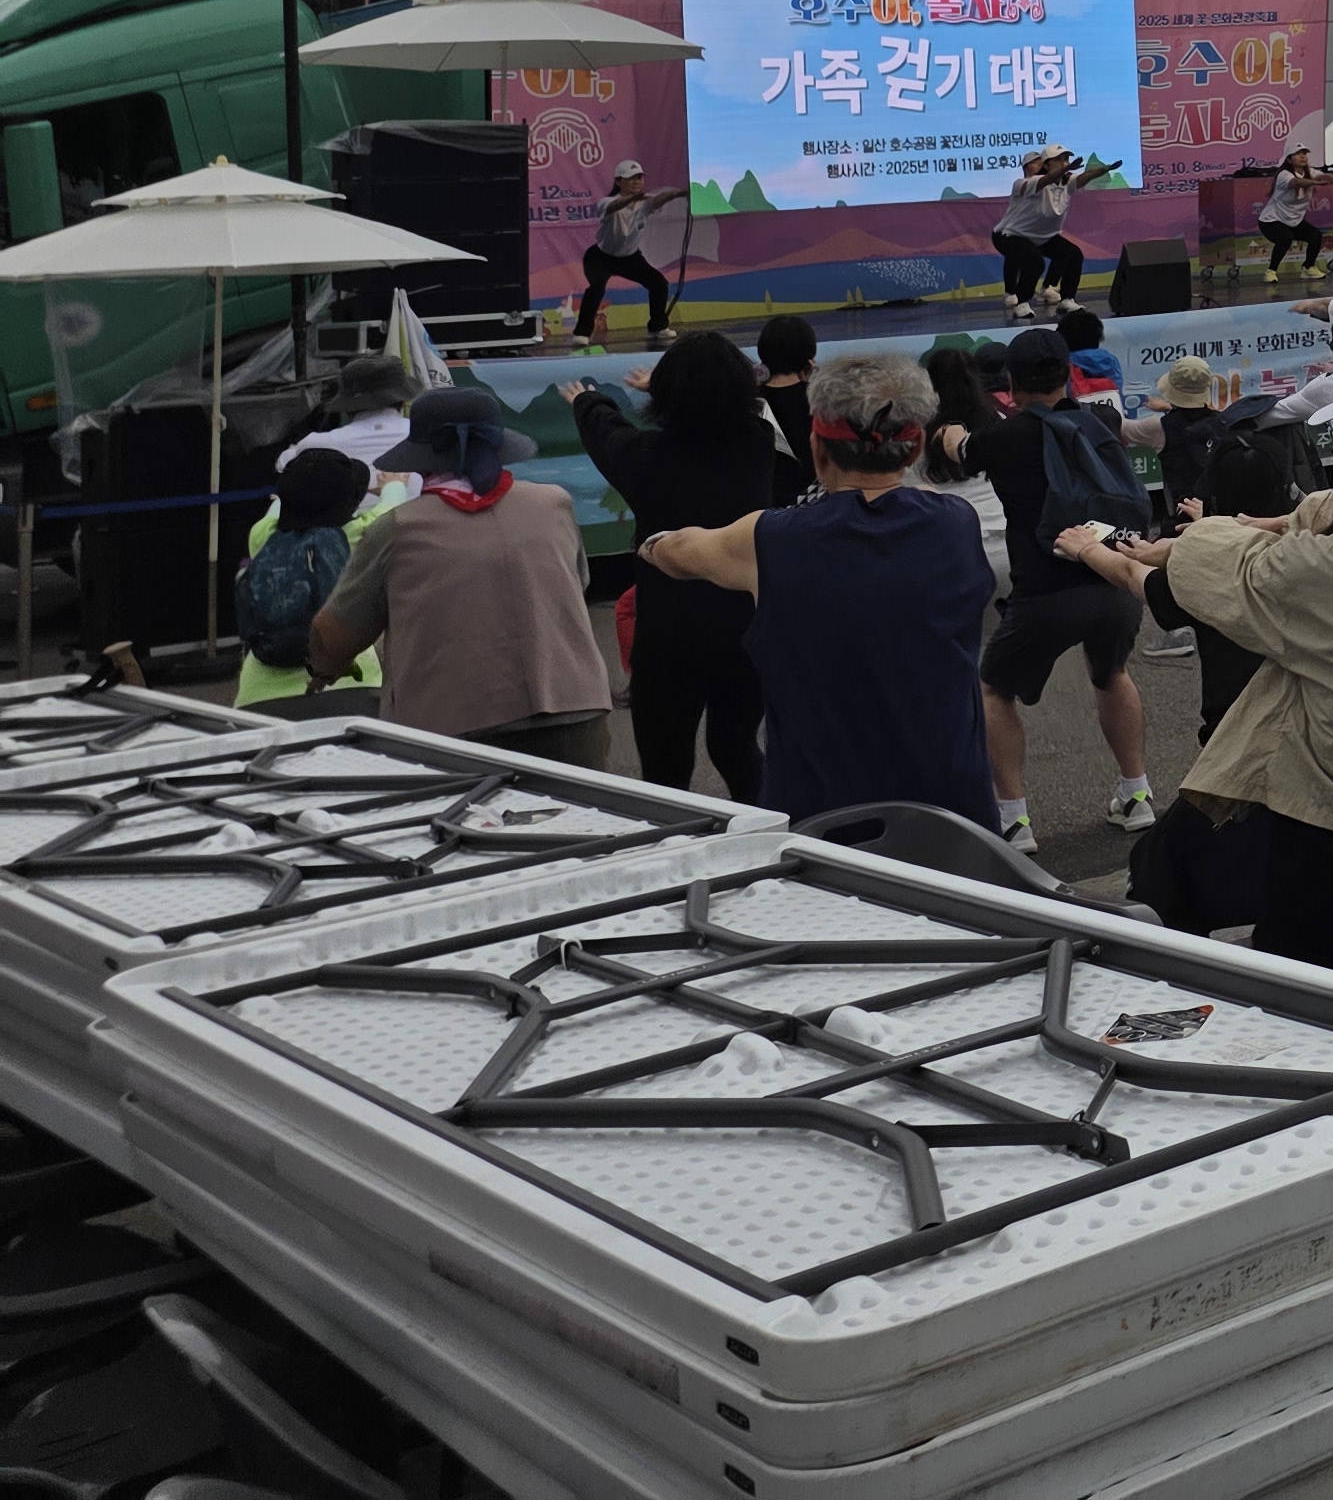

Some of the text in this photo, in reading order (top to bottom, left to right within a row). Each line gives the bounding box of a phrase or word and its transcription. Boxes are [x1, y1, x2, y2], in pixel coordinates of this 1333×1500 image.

[1138, 14, 1170, 27] 2025
[760, 36, 1077, 115] 가족 걷기 대회
[802, 139, 853, 156] 행사장소
[862, 138, 887, 154] 일산
[889, 135, 937, 152] 호수공원
[940, 133, 985, 150] 꽃전시장
[988, 131, 1034, 148] 야외무대
[1036, 131, 1048, 145] 앞
[826, 161, 876, 179] 행사시간
[886, 159, 930, 176] 2025년
[933, 157, 958, 173] 10월
[962, 156, 984, 171] 11일
[1141, 342, 1188, 366] 2025
[1227, 338, 1243, 356] 꽃
[1256, 329, 1331, 354] 문화관광축
